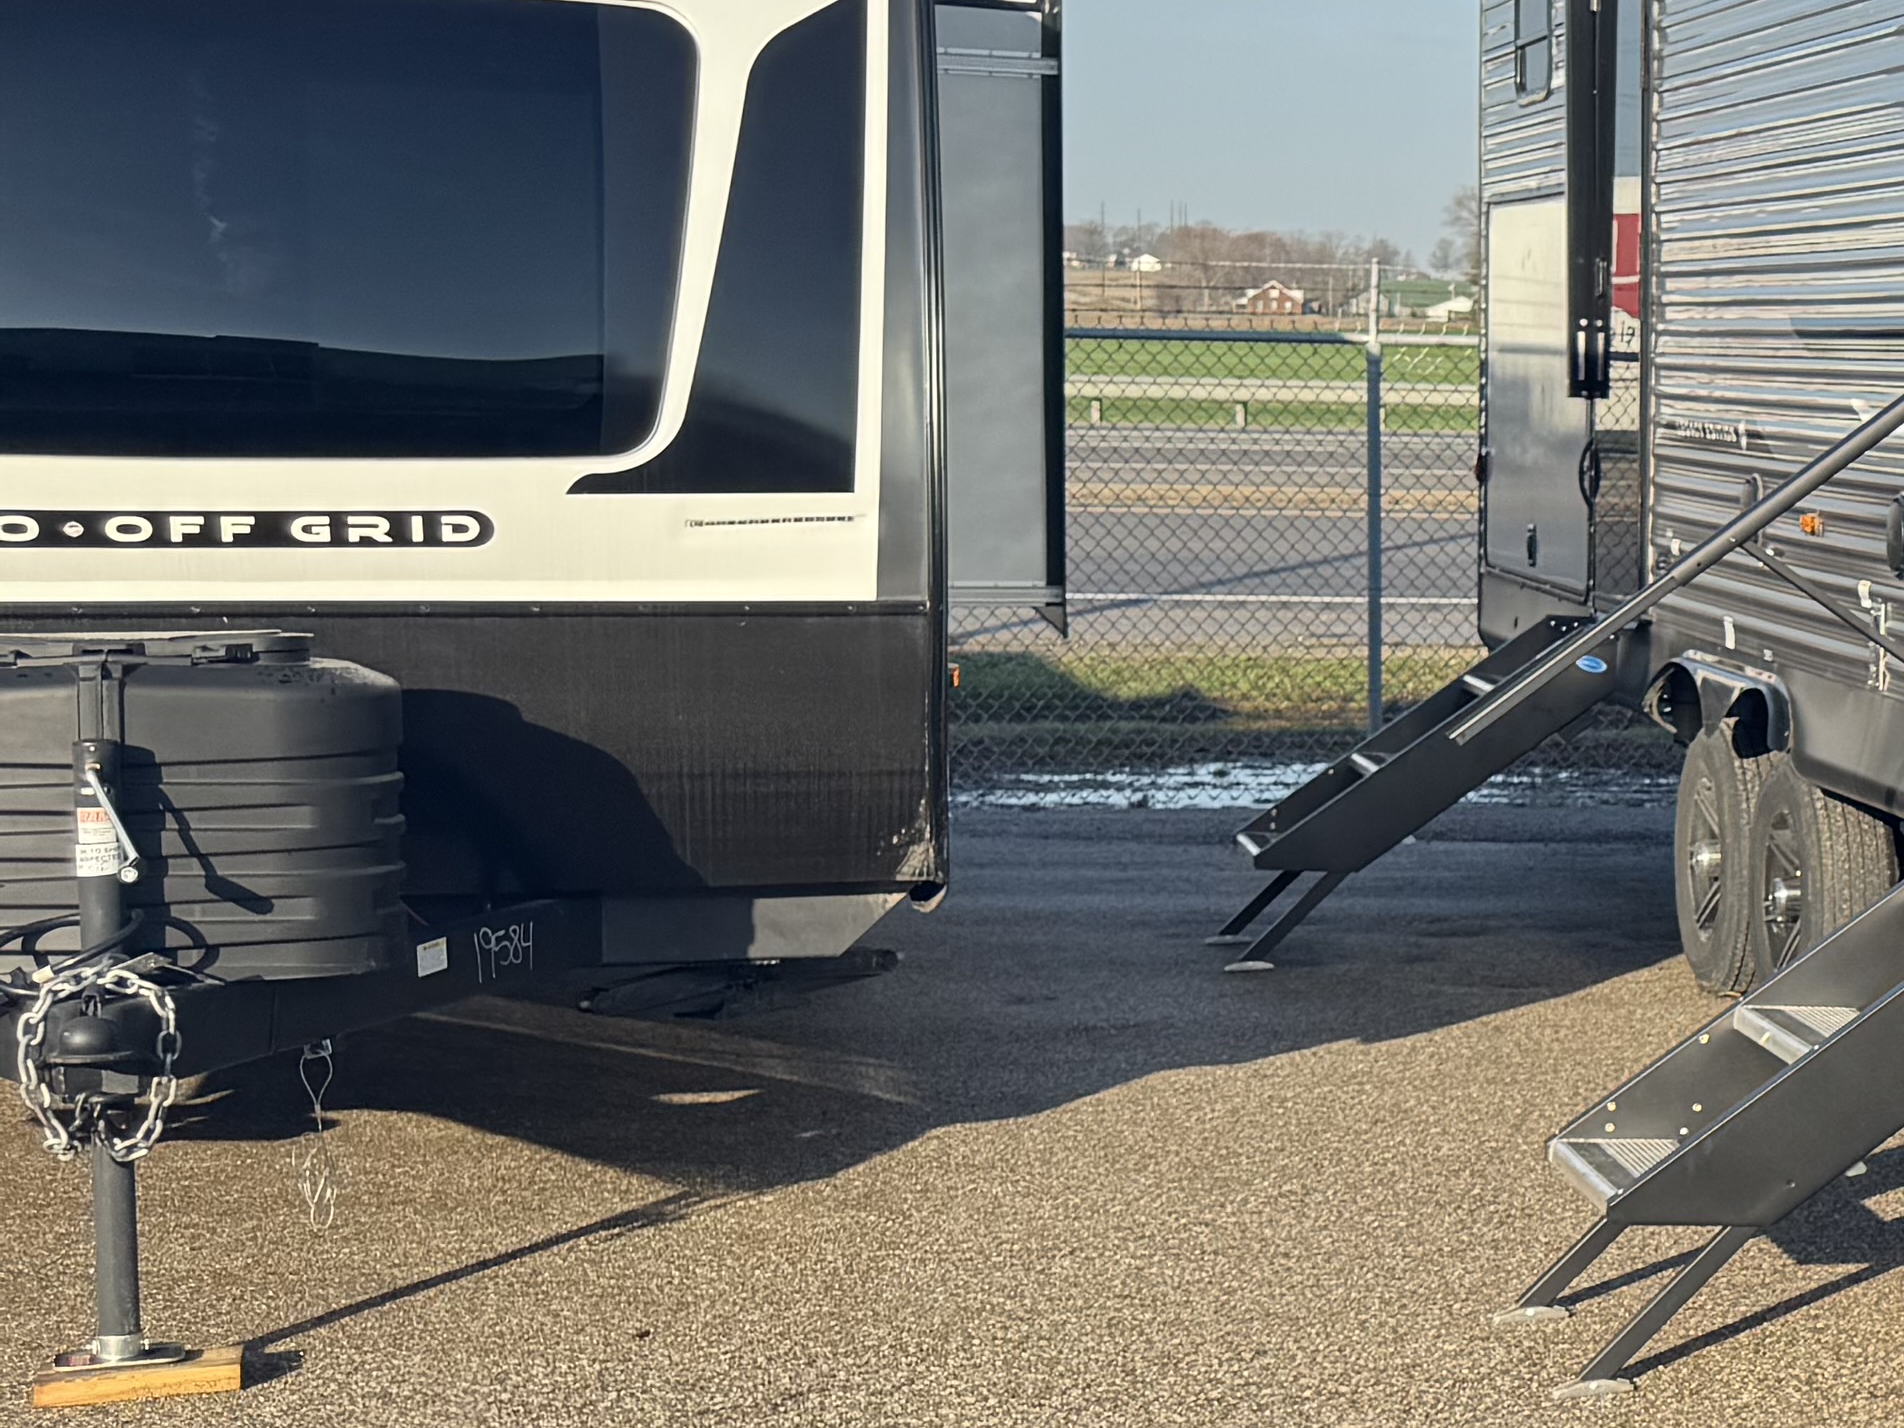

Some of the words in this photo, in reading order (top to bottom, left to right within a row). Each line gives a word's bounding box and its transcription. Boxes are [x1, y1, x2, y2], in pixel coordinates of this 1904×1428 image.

[105, 515, 256, 543] OFF
[290, 515, 481, 543] GRID
[473, 921, 534, 984] 19584
